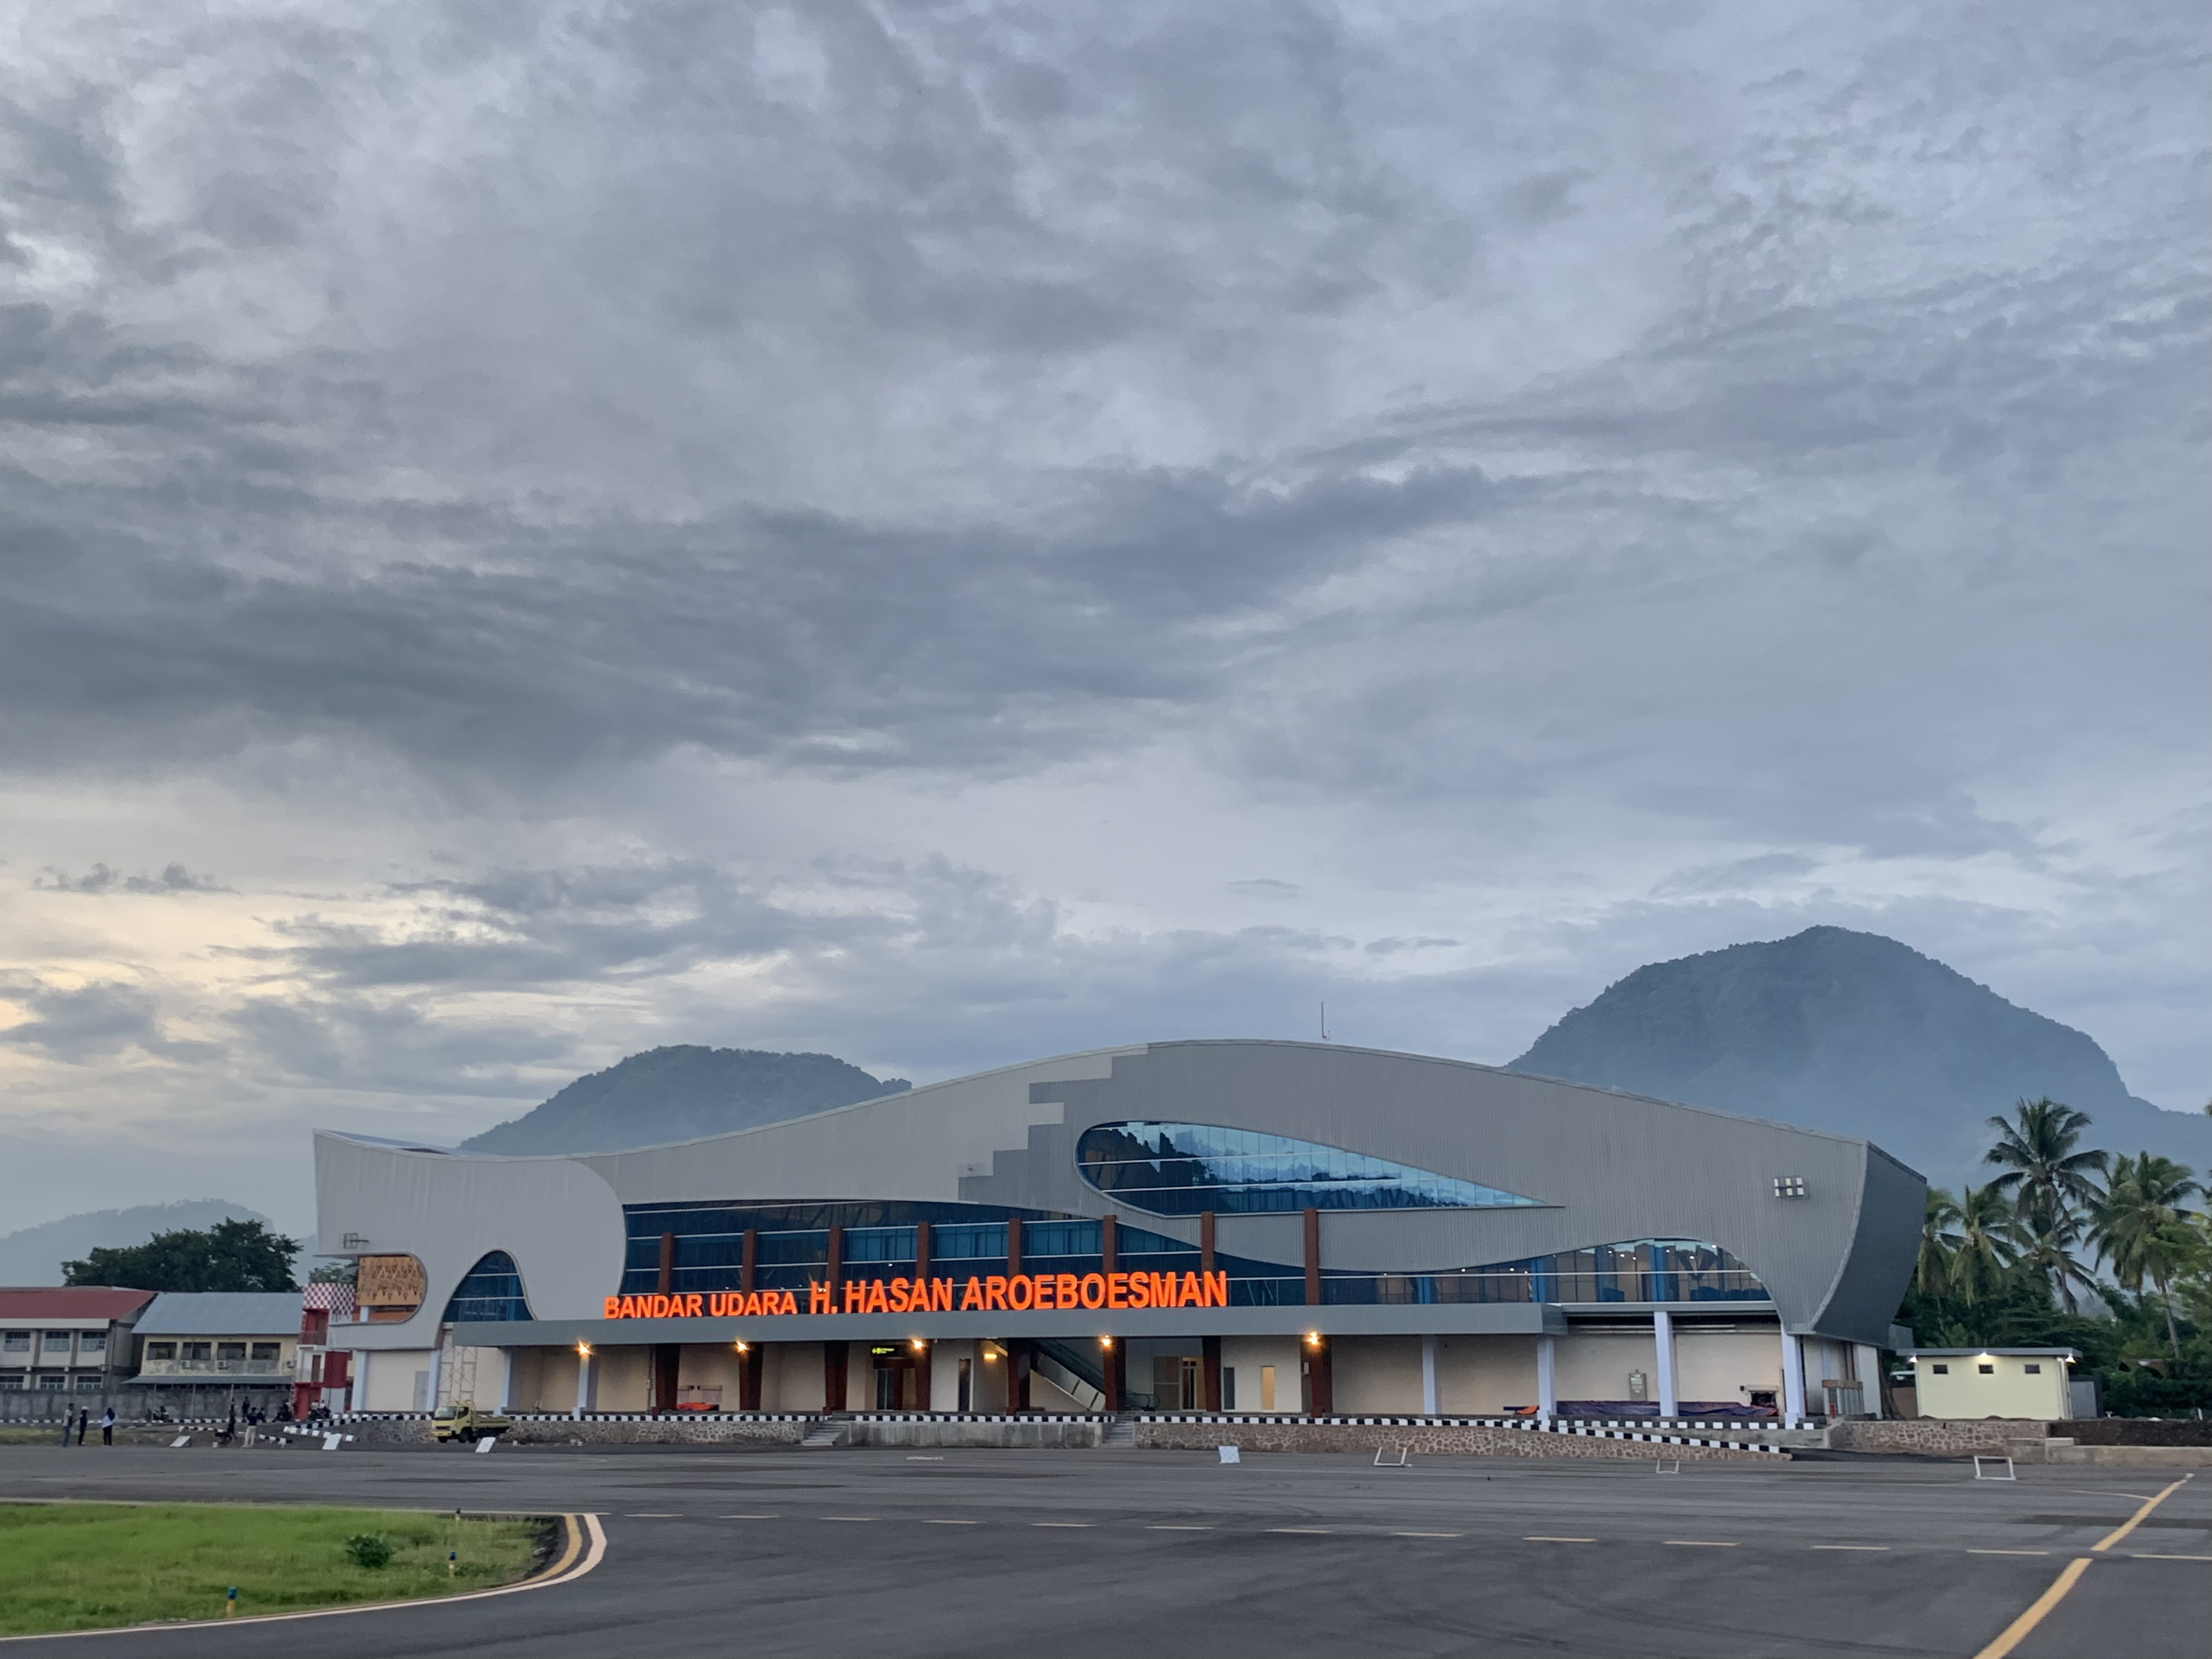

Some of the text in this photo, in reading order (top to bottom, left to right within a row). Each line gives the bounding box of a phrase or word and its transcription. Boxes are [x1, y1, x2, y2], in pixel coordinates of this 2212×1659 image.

[604, 1271, 1227, 1319] BANDAR UDARA H. HASAN AROEBOESMAN
